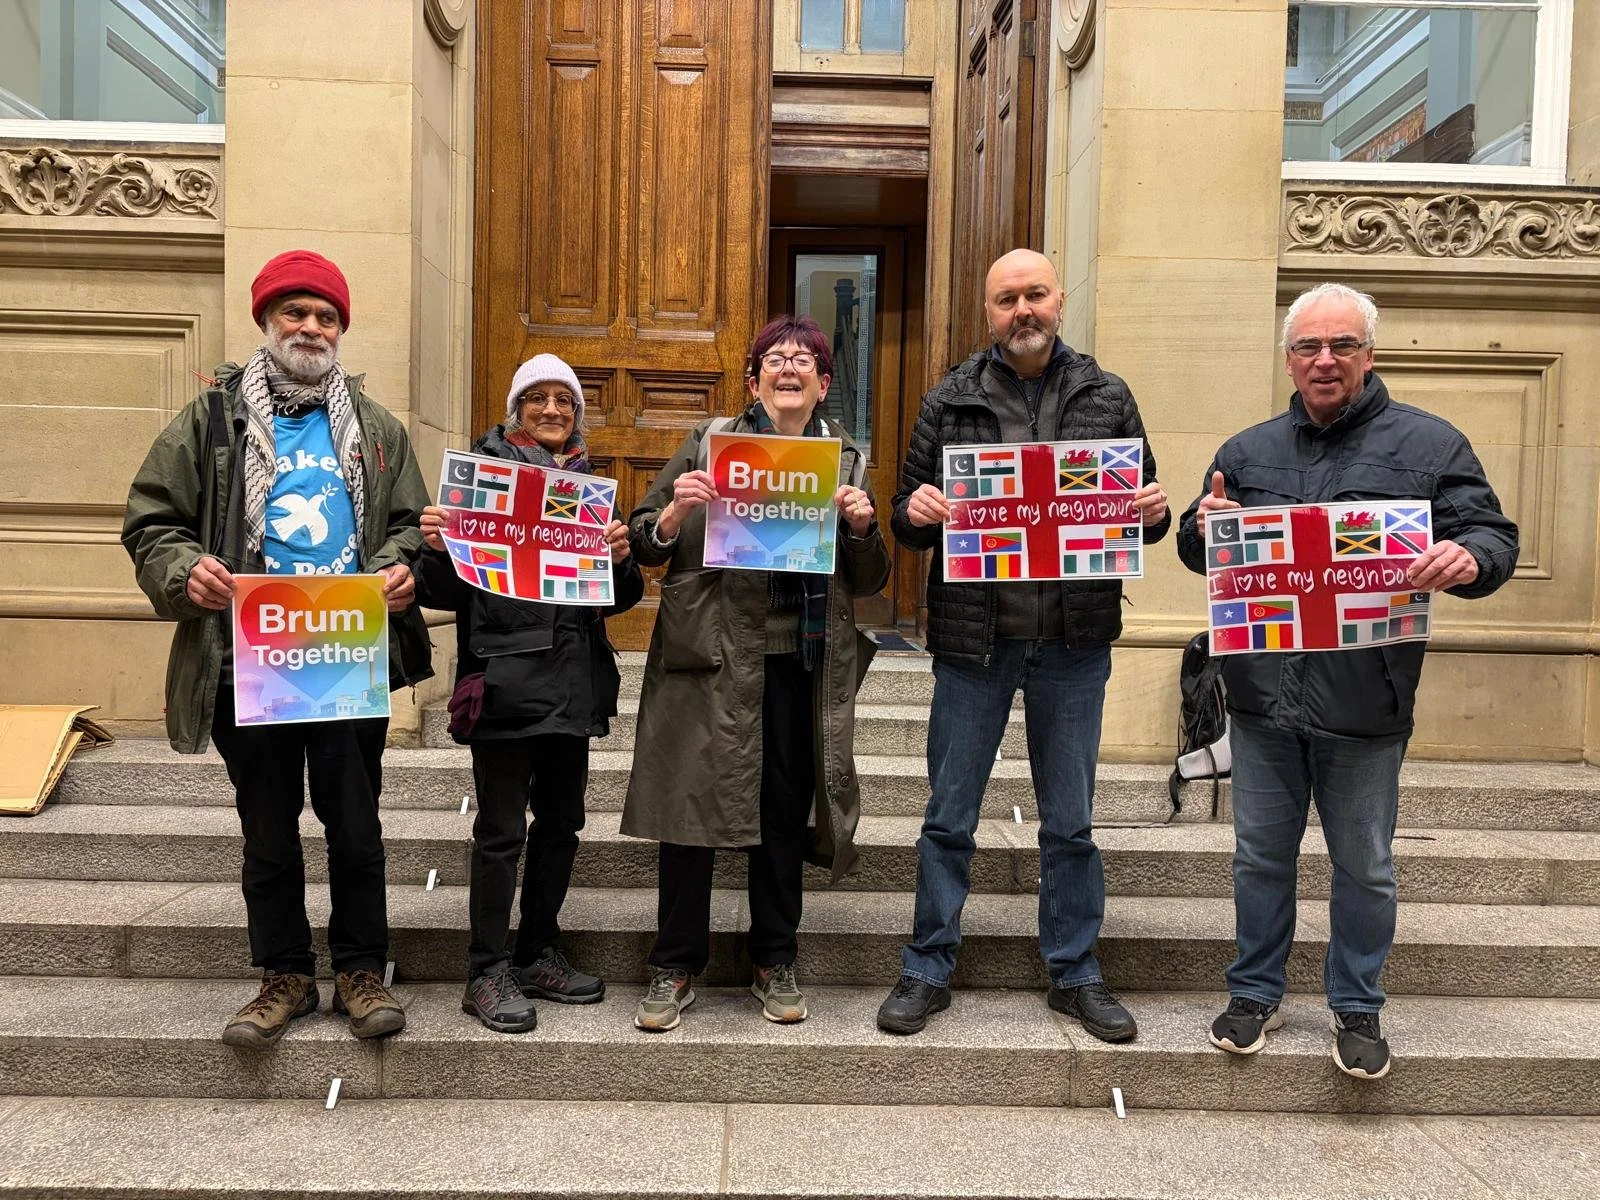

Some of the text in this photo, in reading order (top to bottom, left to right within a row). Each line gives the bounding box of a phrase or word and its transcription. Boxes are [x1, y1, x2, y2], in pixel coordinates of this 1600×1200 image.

[728, 460, 819, 494] Brum
[720, 497, 830, 523] Together
[946, 504, 960, 526] I
[967, 501, 1008, 526] love
[1016, 502, 1041, 526] my
[459, 512, 497, 538] love
[504, 521, 526, 545] my
[1209, 573, 1224, 596] I
[1231, 571, 1277, 595] love
[1287, 570, 1316, 594] my
[258, 603, 365, 635] Brum
[251, 642, 380, 671] Together
